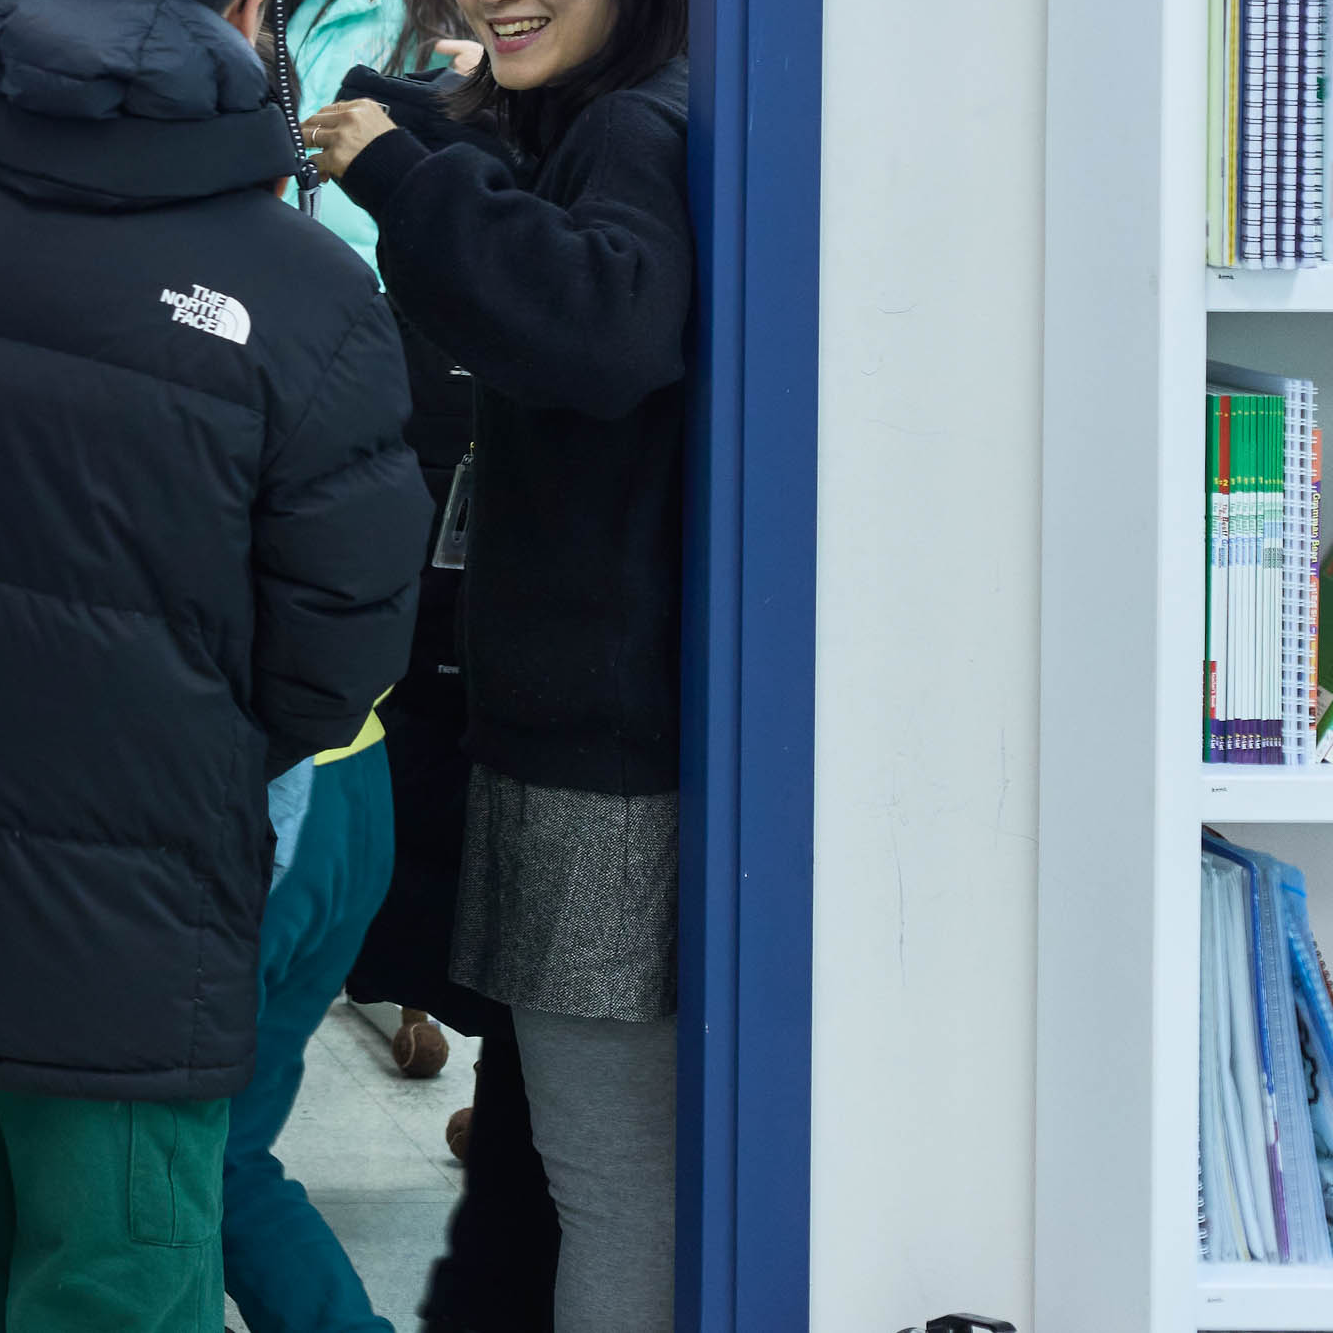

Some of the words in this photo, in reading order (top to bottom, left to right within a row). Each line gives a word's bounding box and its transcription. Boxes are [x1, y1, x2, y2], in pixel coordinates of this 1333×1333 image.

[159, 288, 222, 321] NORTH
[191, 283, 227, 308] THE
[171, 307, 219, 336] FACE
